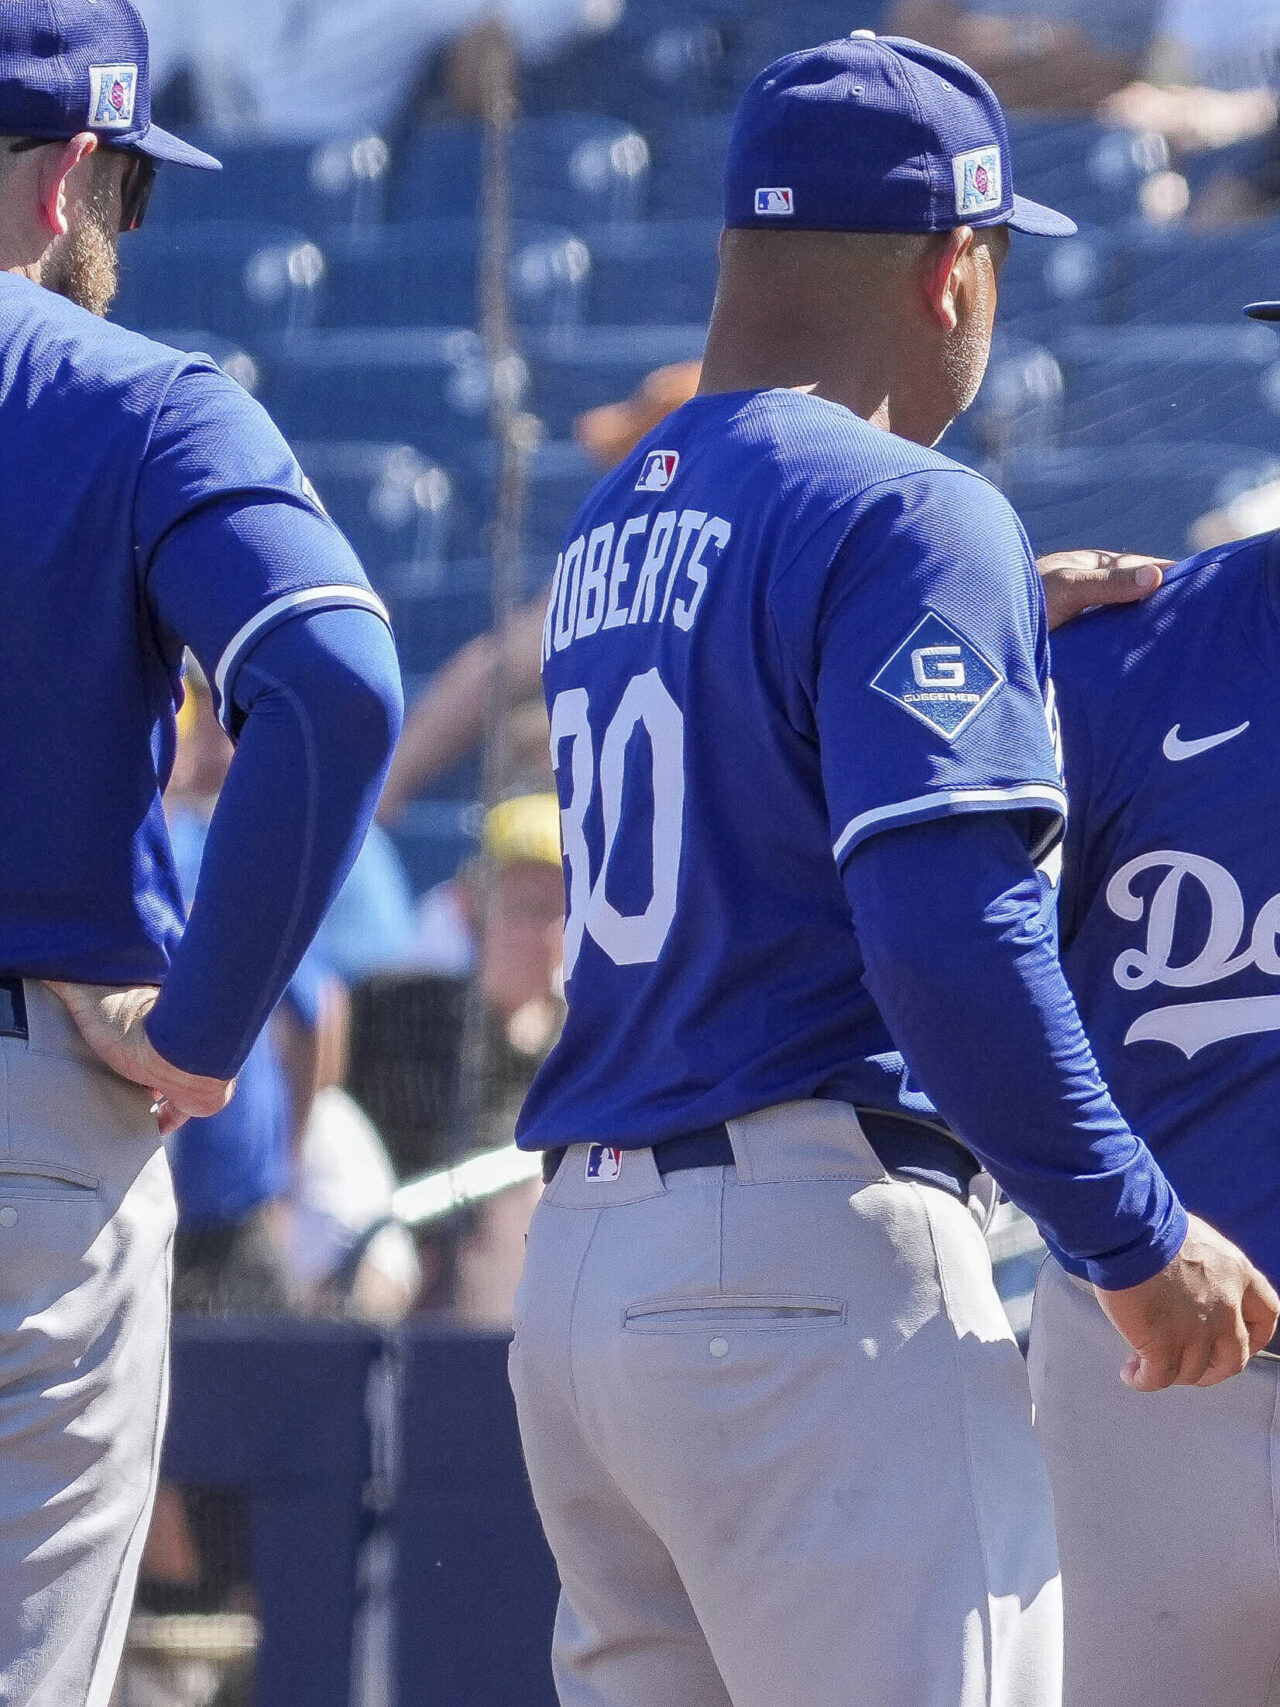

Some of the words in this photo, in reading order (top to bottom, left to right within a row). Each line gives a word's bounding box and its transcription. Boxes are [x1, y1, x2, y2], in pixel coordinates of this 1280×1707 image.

[911, 645, 965, 687] G
[903, 692, 980, 703] GUGGENHEIM
[550, 666, 685, 982] 30
